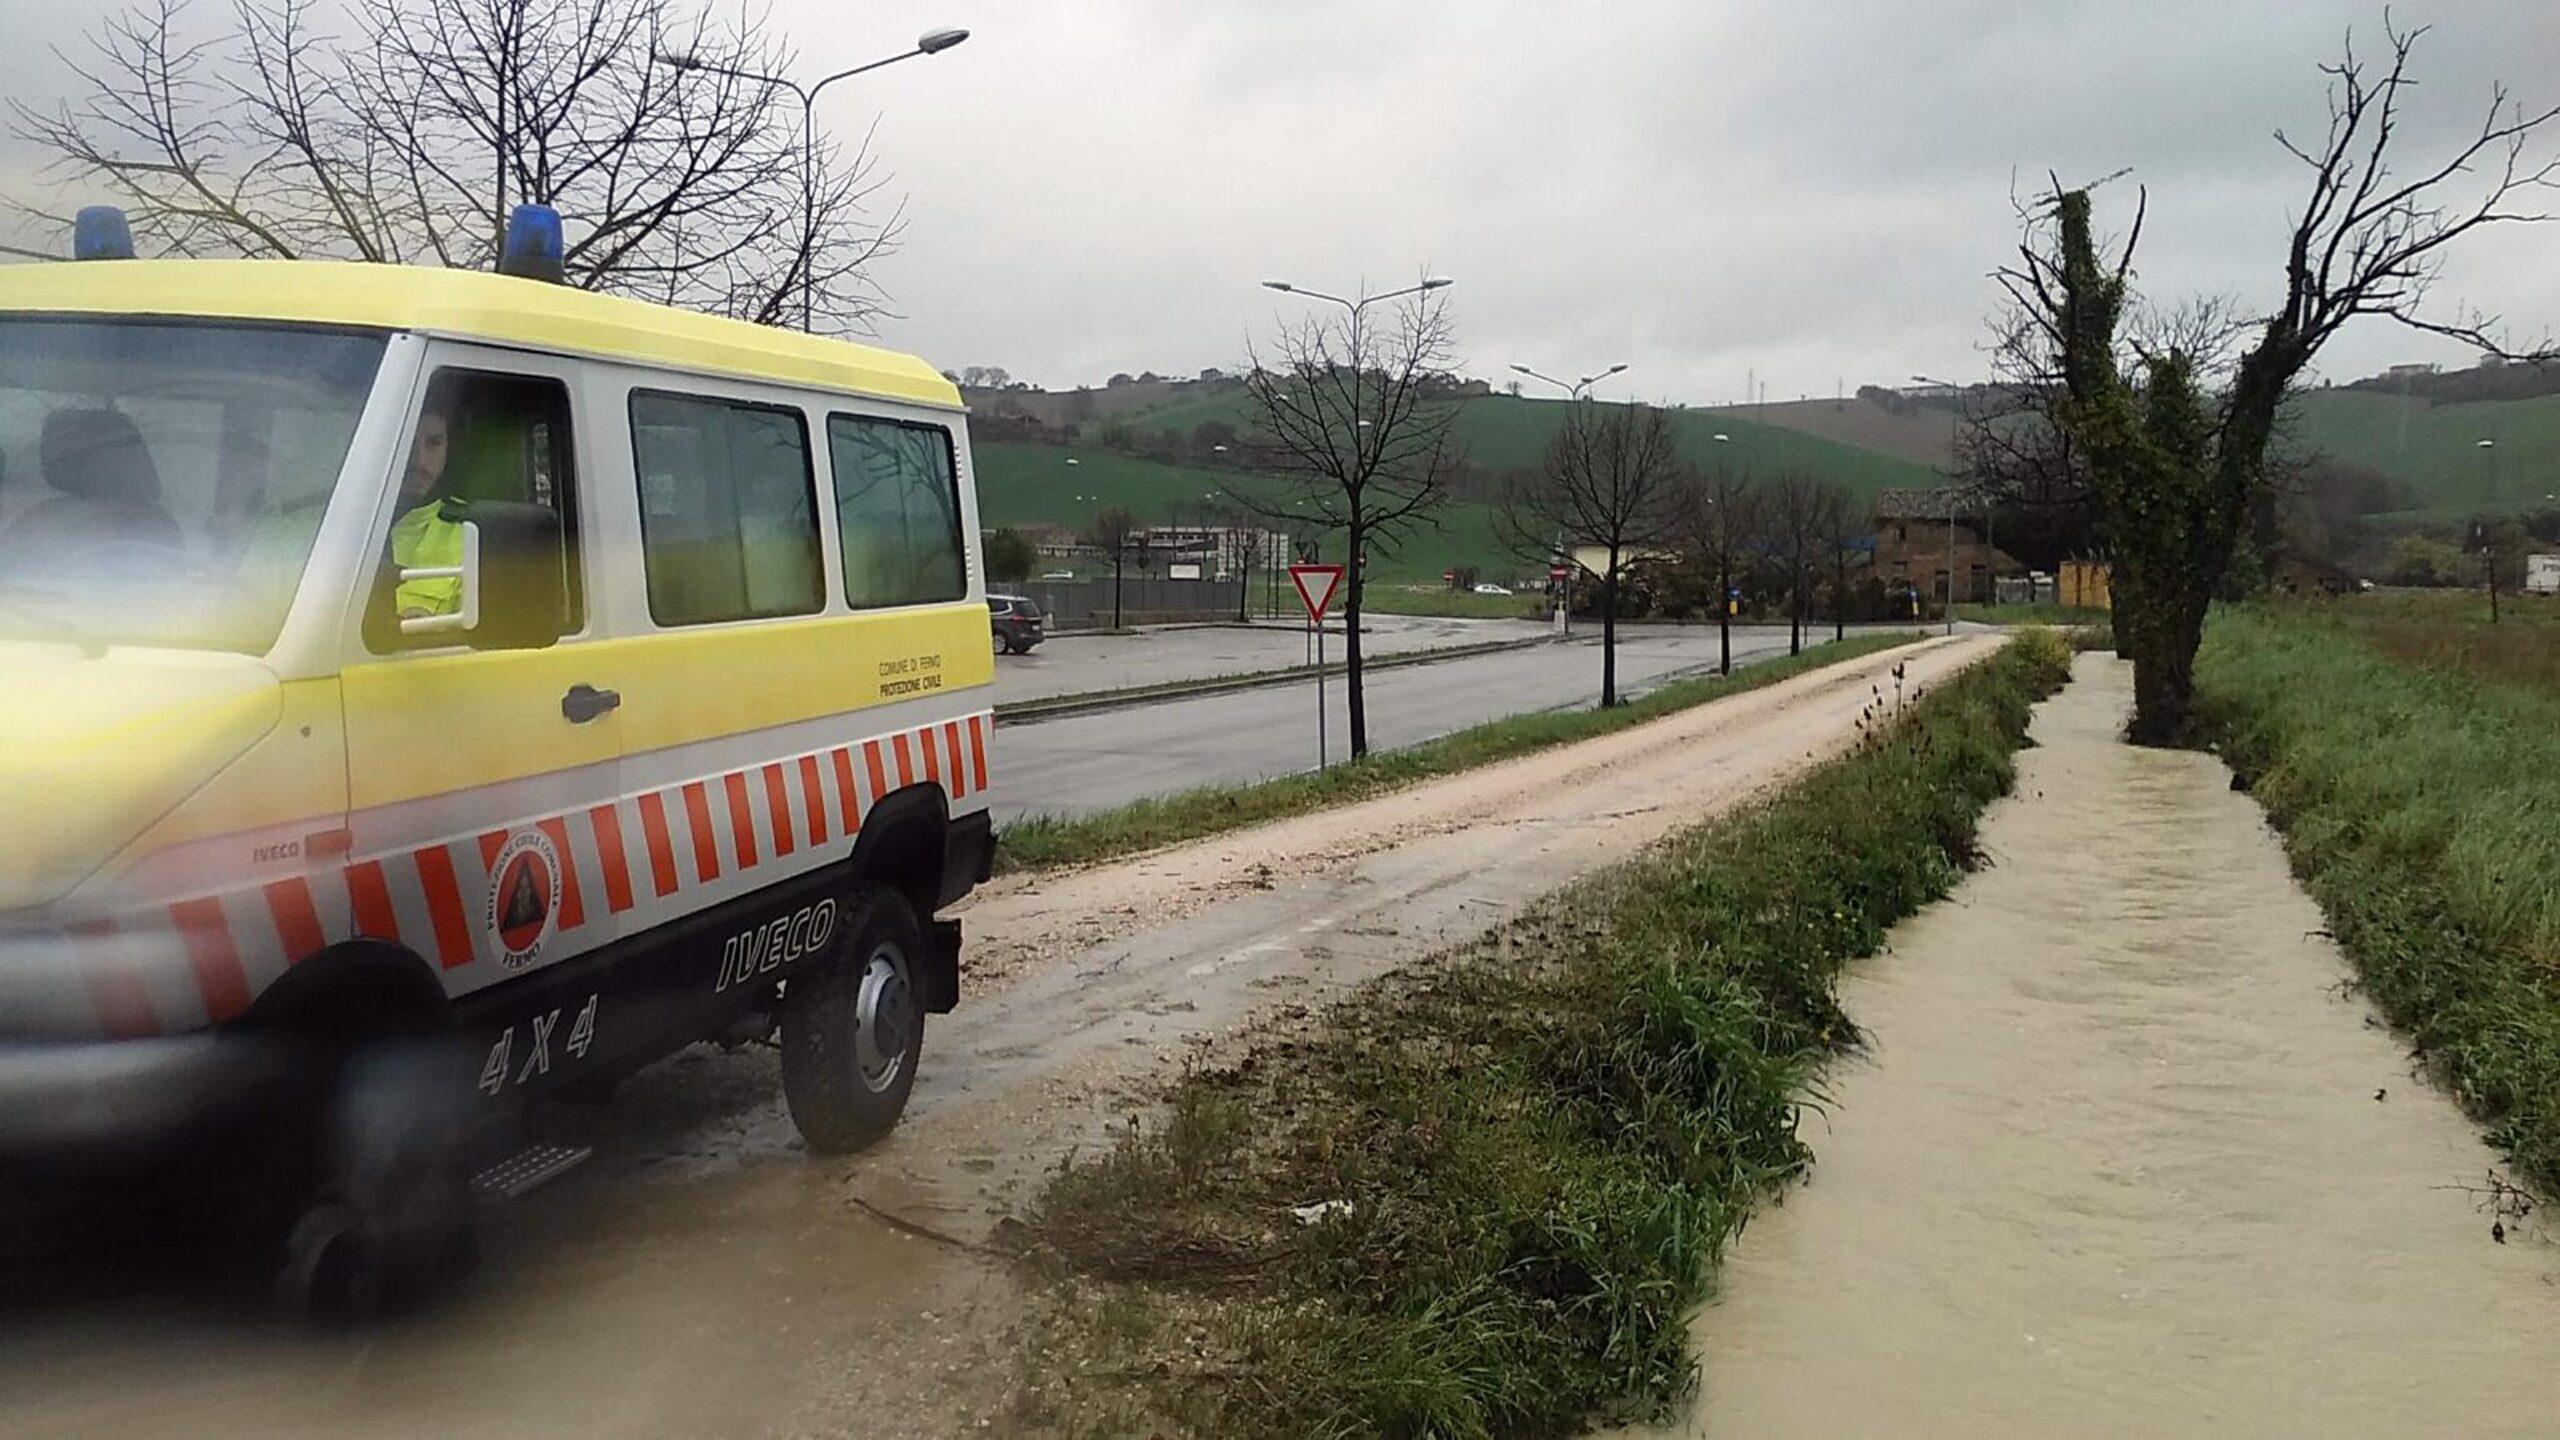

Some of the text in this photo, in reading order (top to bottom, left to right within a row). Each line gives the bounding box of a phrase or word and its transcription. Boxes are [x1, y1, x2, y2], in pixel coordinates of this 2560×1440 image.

[880, 654, 940, 676] COMUNE DI FERMO
[880, 674, 941, 697] PROTEZIONE CIVILE
[253, 841, 299, 862] IVECO
[502, 941, 541, 969] FERMO
[715, 898, 836, 993] IVECO
